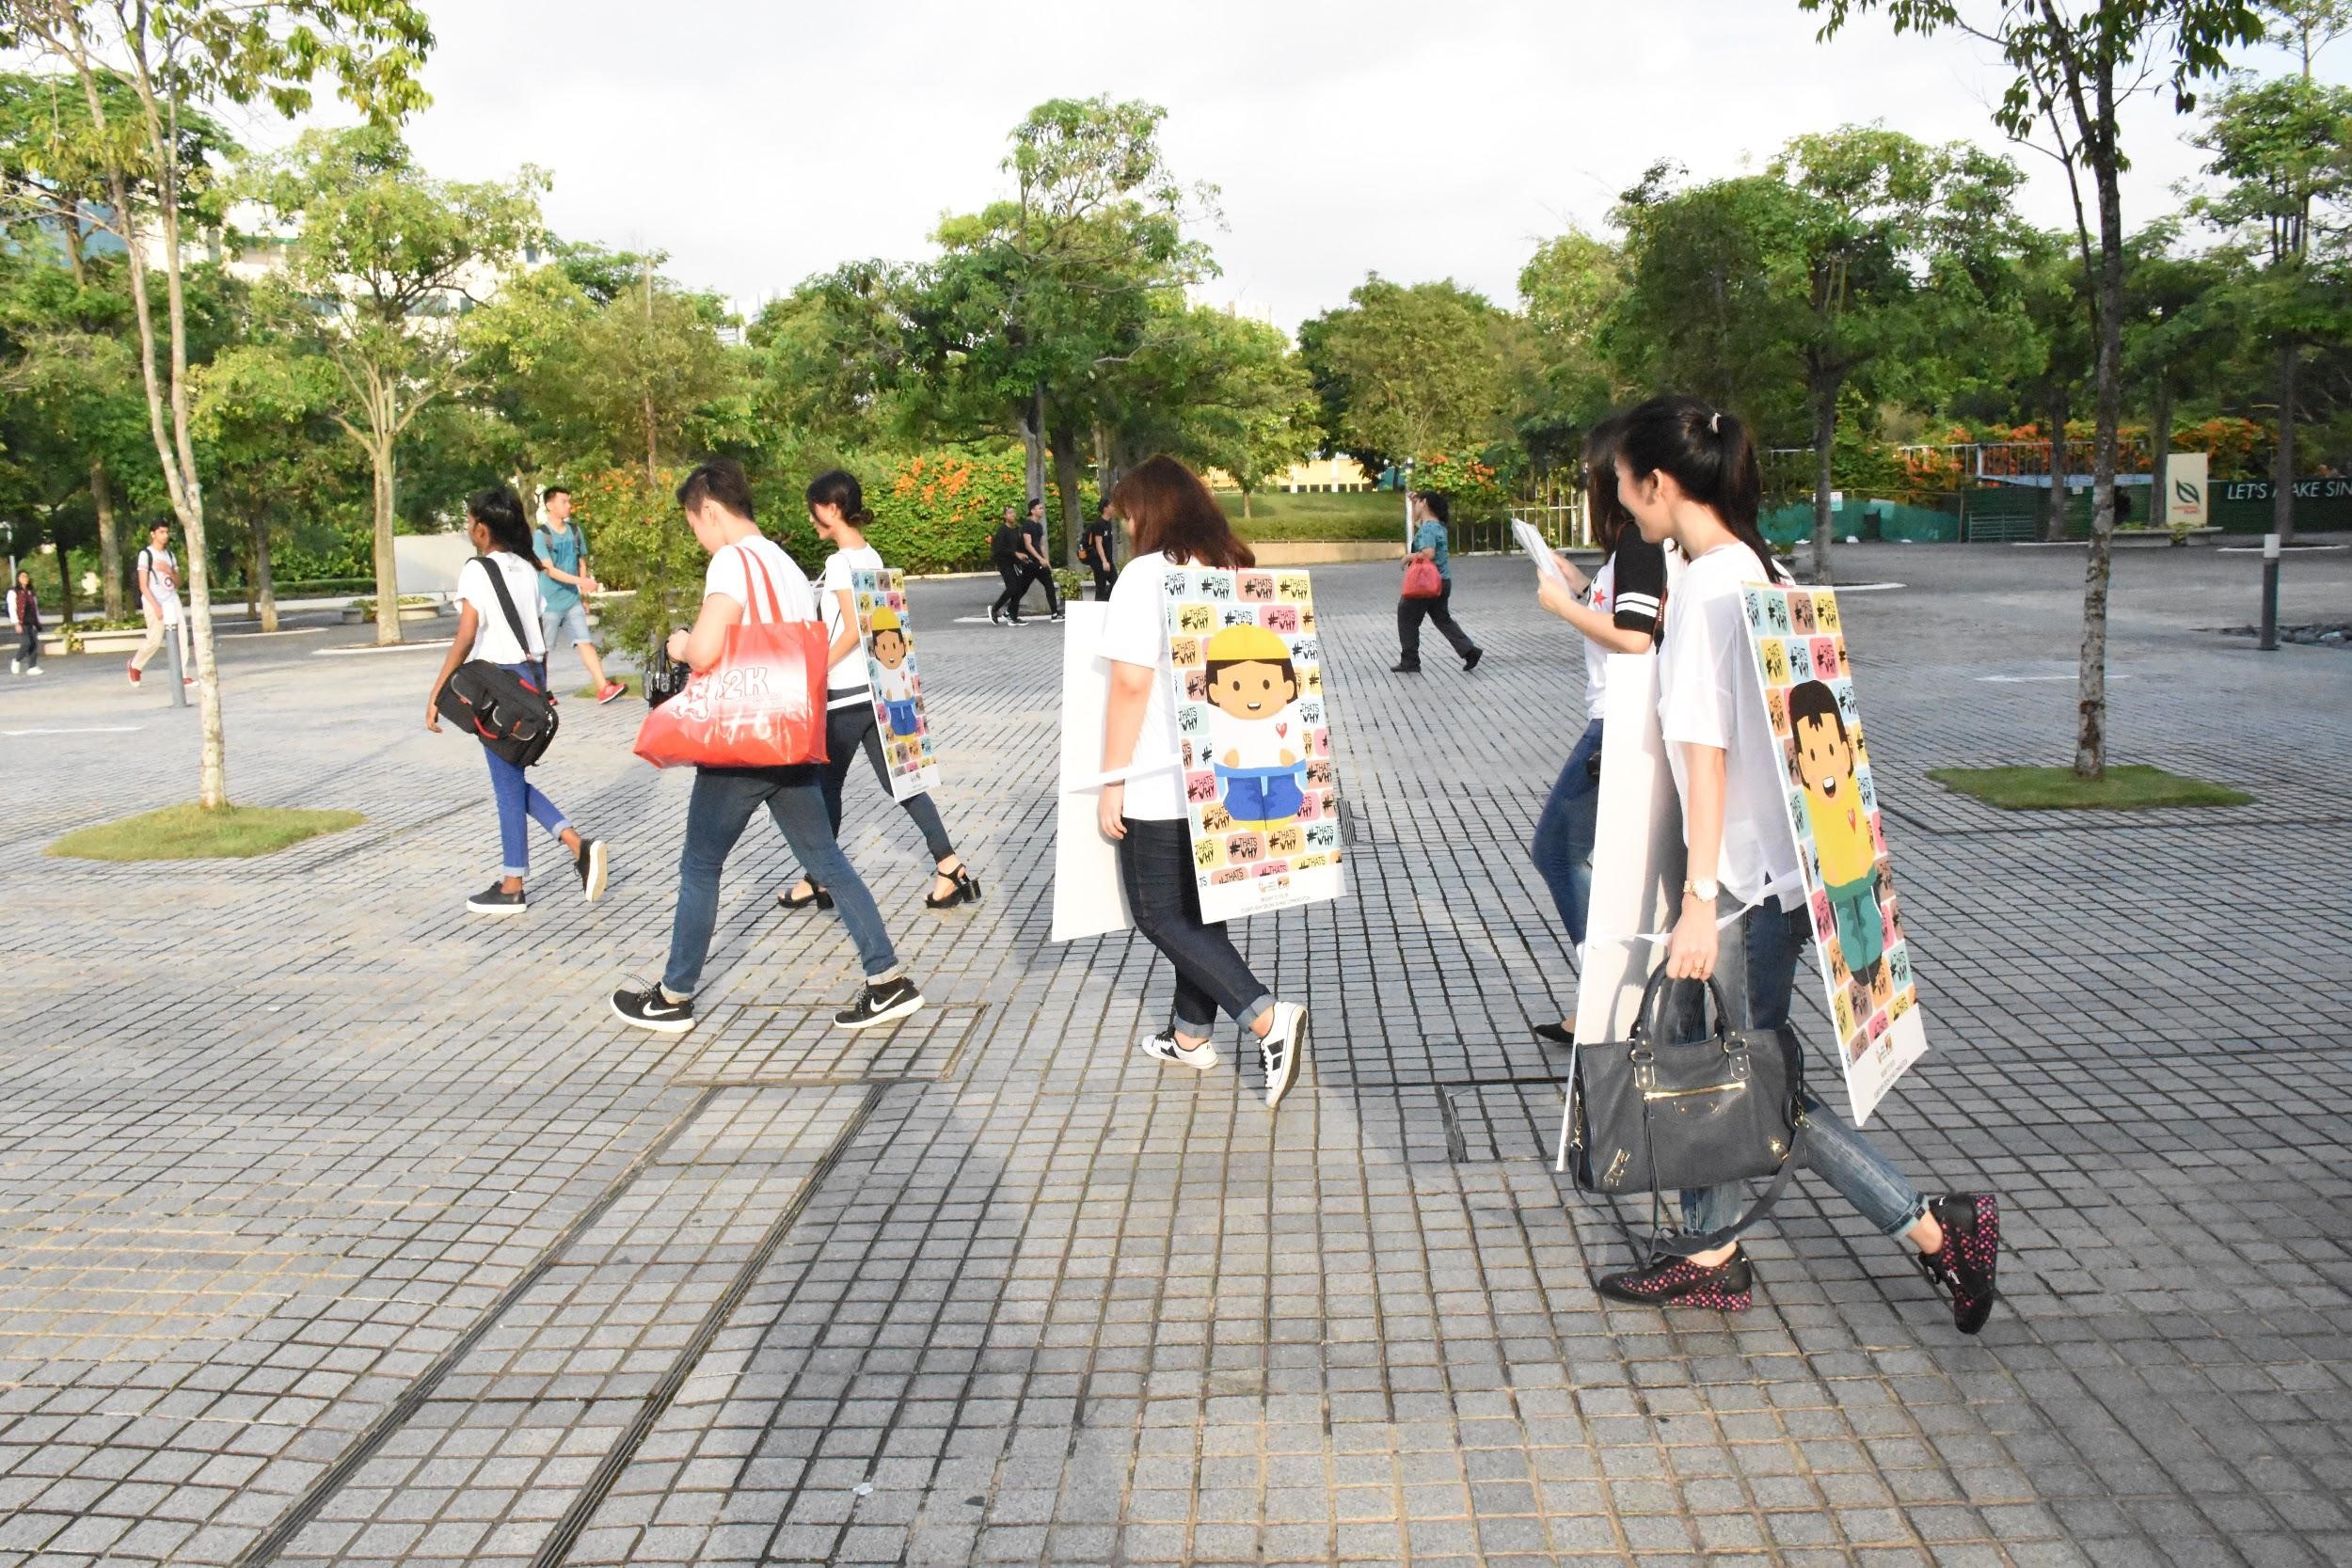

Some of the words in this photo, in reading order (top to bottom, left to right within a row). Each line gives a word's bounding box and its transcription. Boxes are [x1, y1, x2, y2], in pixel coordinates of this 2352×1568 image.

[2227, 483, 2267, 499] LET'S
[2271, 482, 2321, 498] AKE
[1168, 582, 1185, 595] WHY
[1201, 577, 1230, 594] #THATS
[1244, 578, 1273, 595] #THATS
[1279, 579, 1309, 594] #THATS
[1213, 588, 1230, 600] WHY
[1256, 588, 1273, 599] WHY
[1291, 589, 1308, 600] WHY
[1181, 607, 1209, 631] #THATS
[1192, 616, 1209, 629] WHY
[1225, 610, 1253, 627] #THATS
[1267, 610, 1295, 628] #THATS
[1279, 620, 1295, 630] WHY
[1180, 650, 1196, 664] WHY
[1182, 717, 1198, 731] WHY
[1303, 714, 1319, 723] WHY
[1187, 775, 1214, 802] #THATS
[1198, 784, 1215, 800] WHY
[1214, 816, 1230, 830] WHY
[1268, 829, 1296, 850] #THATS
[1307, 826, 1334, 845] #THATS
[1317, 834, 1334, 846] WHY
[1229, 837, 1258, 858] #THATS
[1279, 839, 1296, 850] WHY
[1198, 848, 1214, 864] WHY
[1240, 847, 1258, 859] WHY
